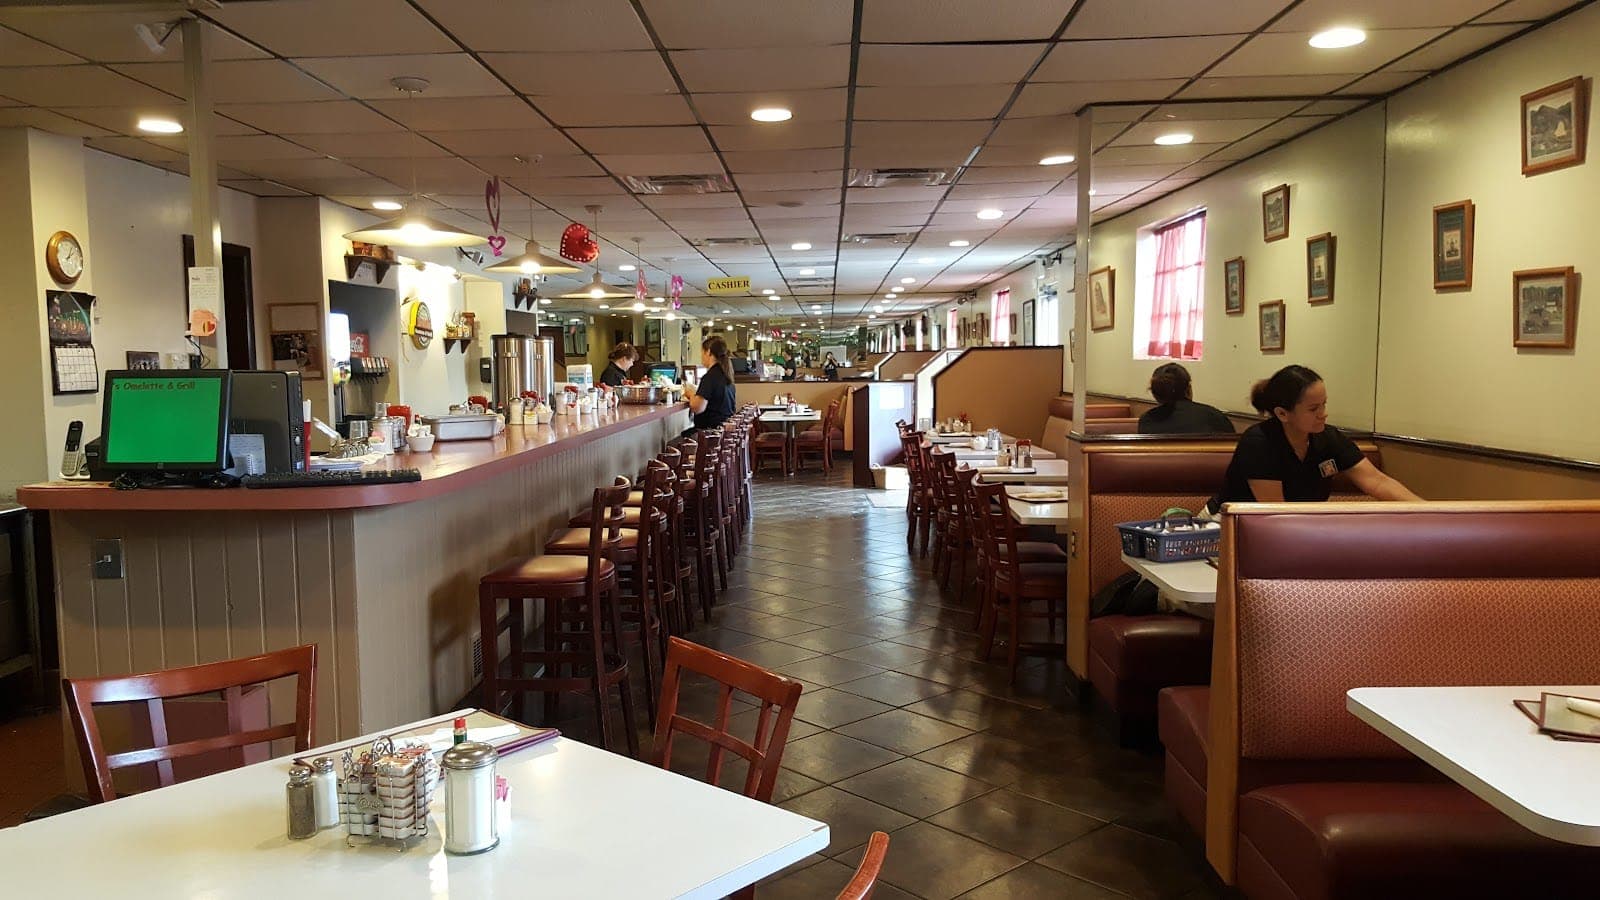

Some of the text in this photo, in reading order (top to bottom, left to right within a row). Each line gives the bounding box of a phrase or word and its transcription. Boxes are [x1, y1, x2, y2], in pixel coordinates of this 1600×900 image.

[708, 280, 749, 290] CASHIER
[167, 382, 174, 390] &
[177, 382, 196, 390] Grill
